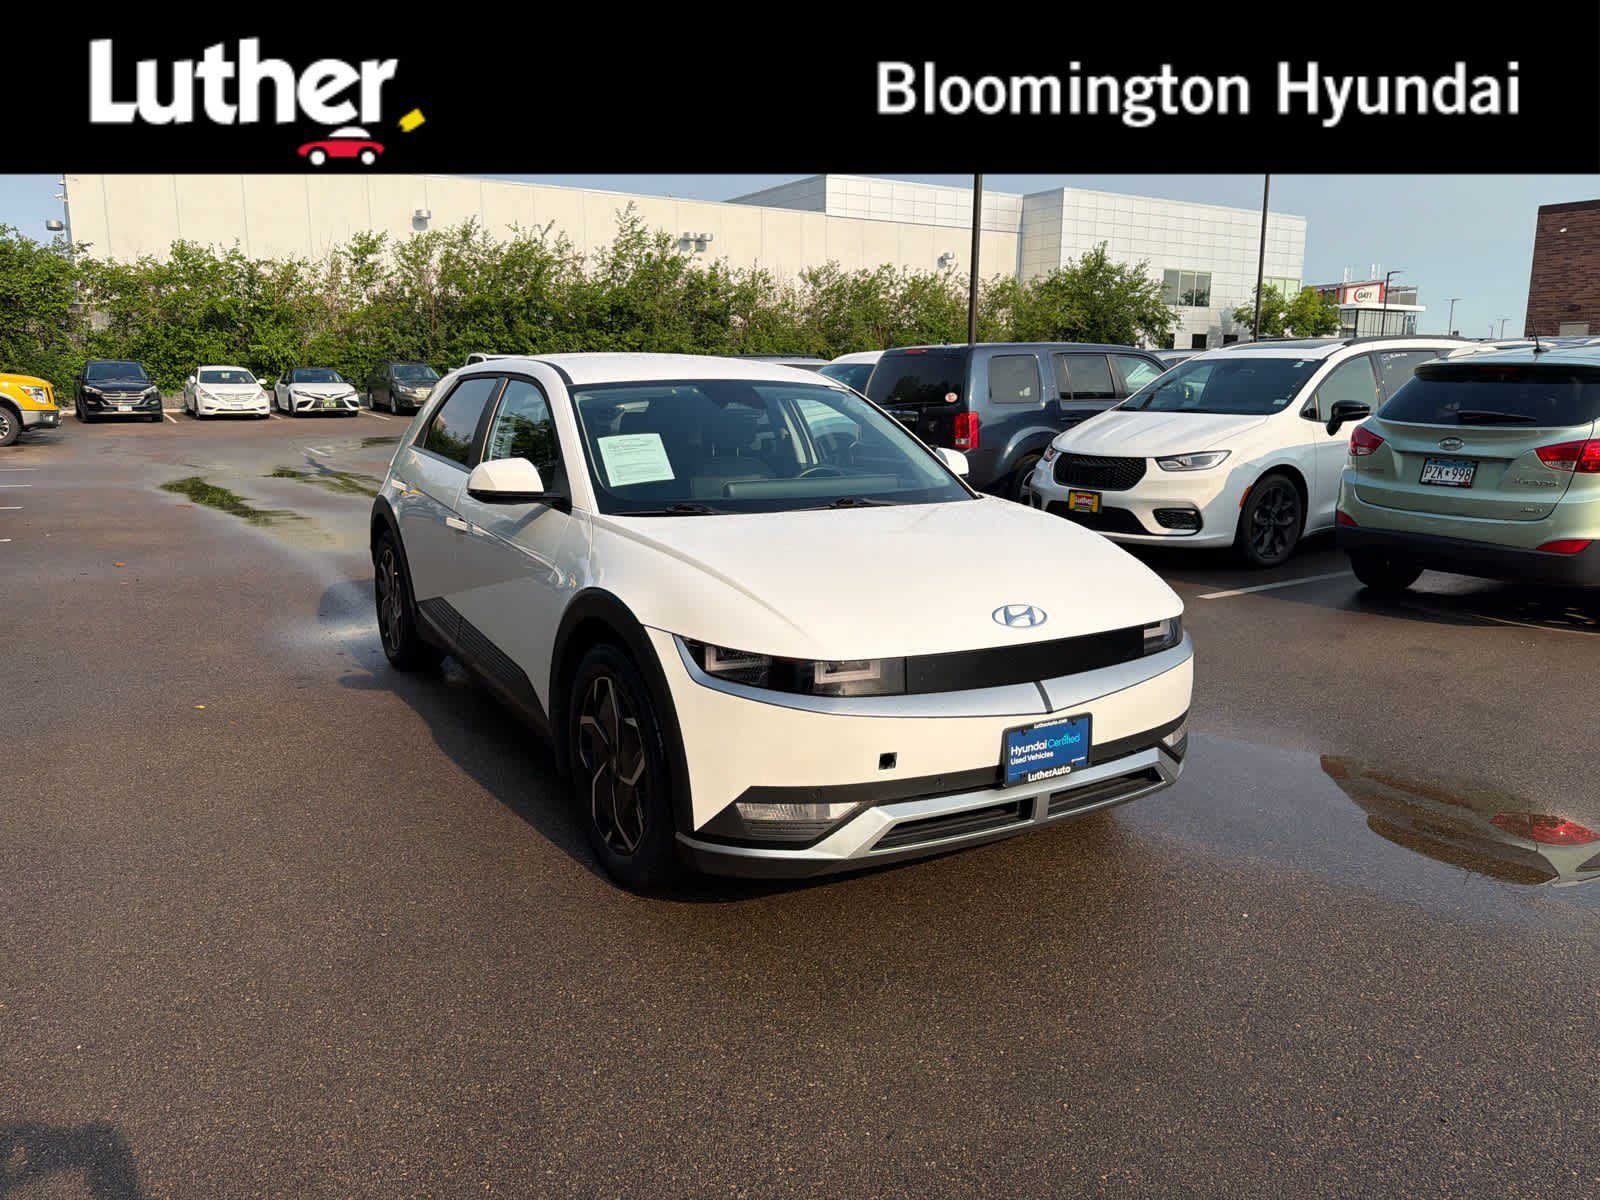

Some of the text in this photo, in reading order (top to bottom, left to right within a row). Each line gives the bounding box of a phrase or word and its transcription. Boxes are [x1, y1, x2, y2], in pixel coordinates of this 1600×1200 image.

[1010, 733, 1080, 757] Hyundai Certified
[1010, 751, 1054, 766] Used Vehicles
[1028, 766, 1071, 782] LutherAuto
